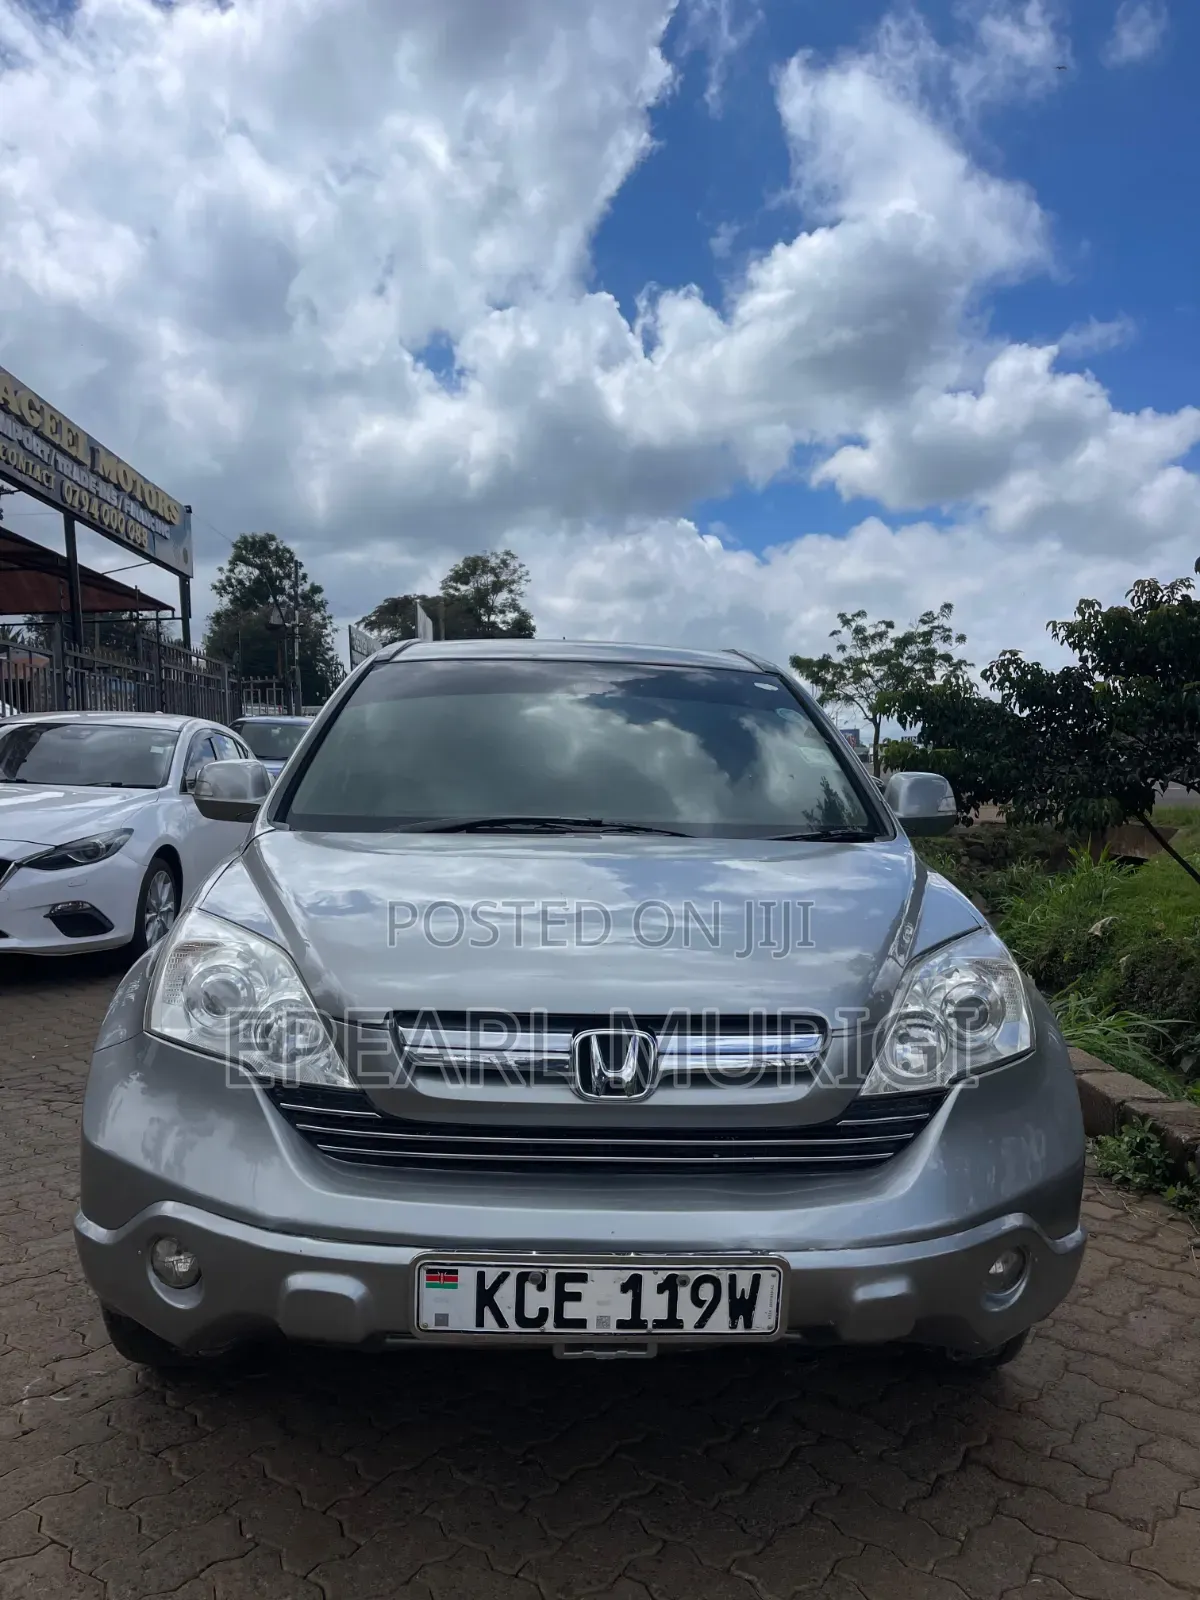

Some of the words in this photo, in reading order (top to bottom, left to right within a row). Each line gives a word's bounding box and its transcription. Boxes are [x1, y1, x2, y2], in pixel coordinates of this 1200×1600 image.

[0, 443, 55, 489] CONTACT
[62, 479, 100, 519] 0794
[102, 503, 125, 534] 000
[94, 446, 181, 525] MOTORS
[475, 1271, 588, 1328] KCE
[616, 1273, 761, 1329] 119W
